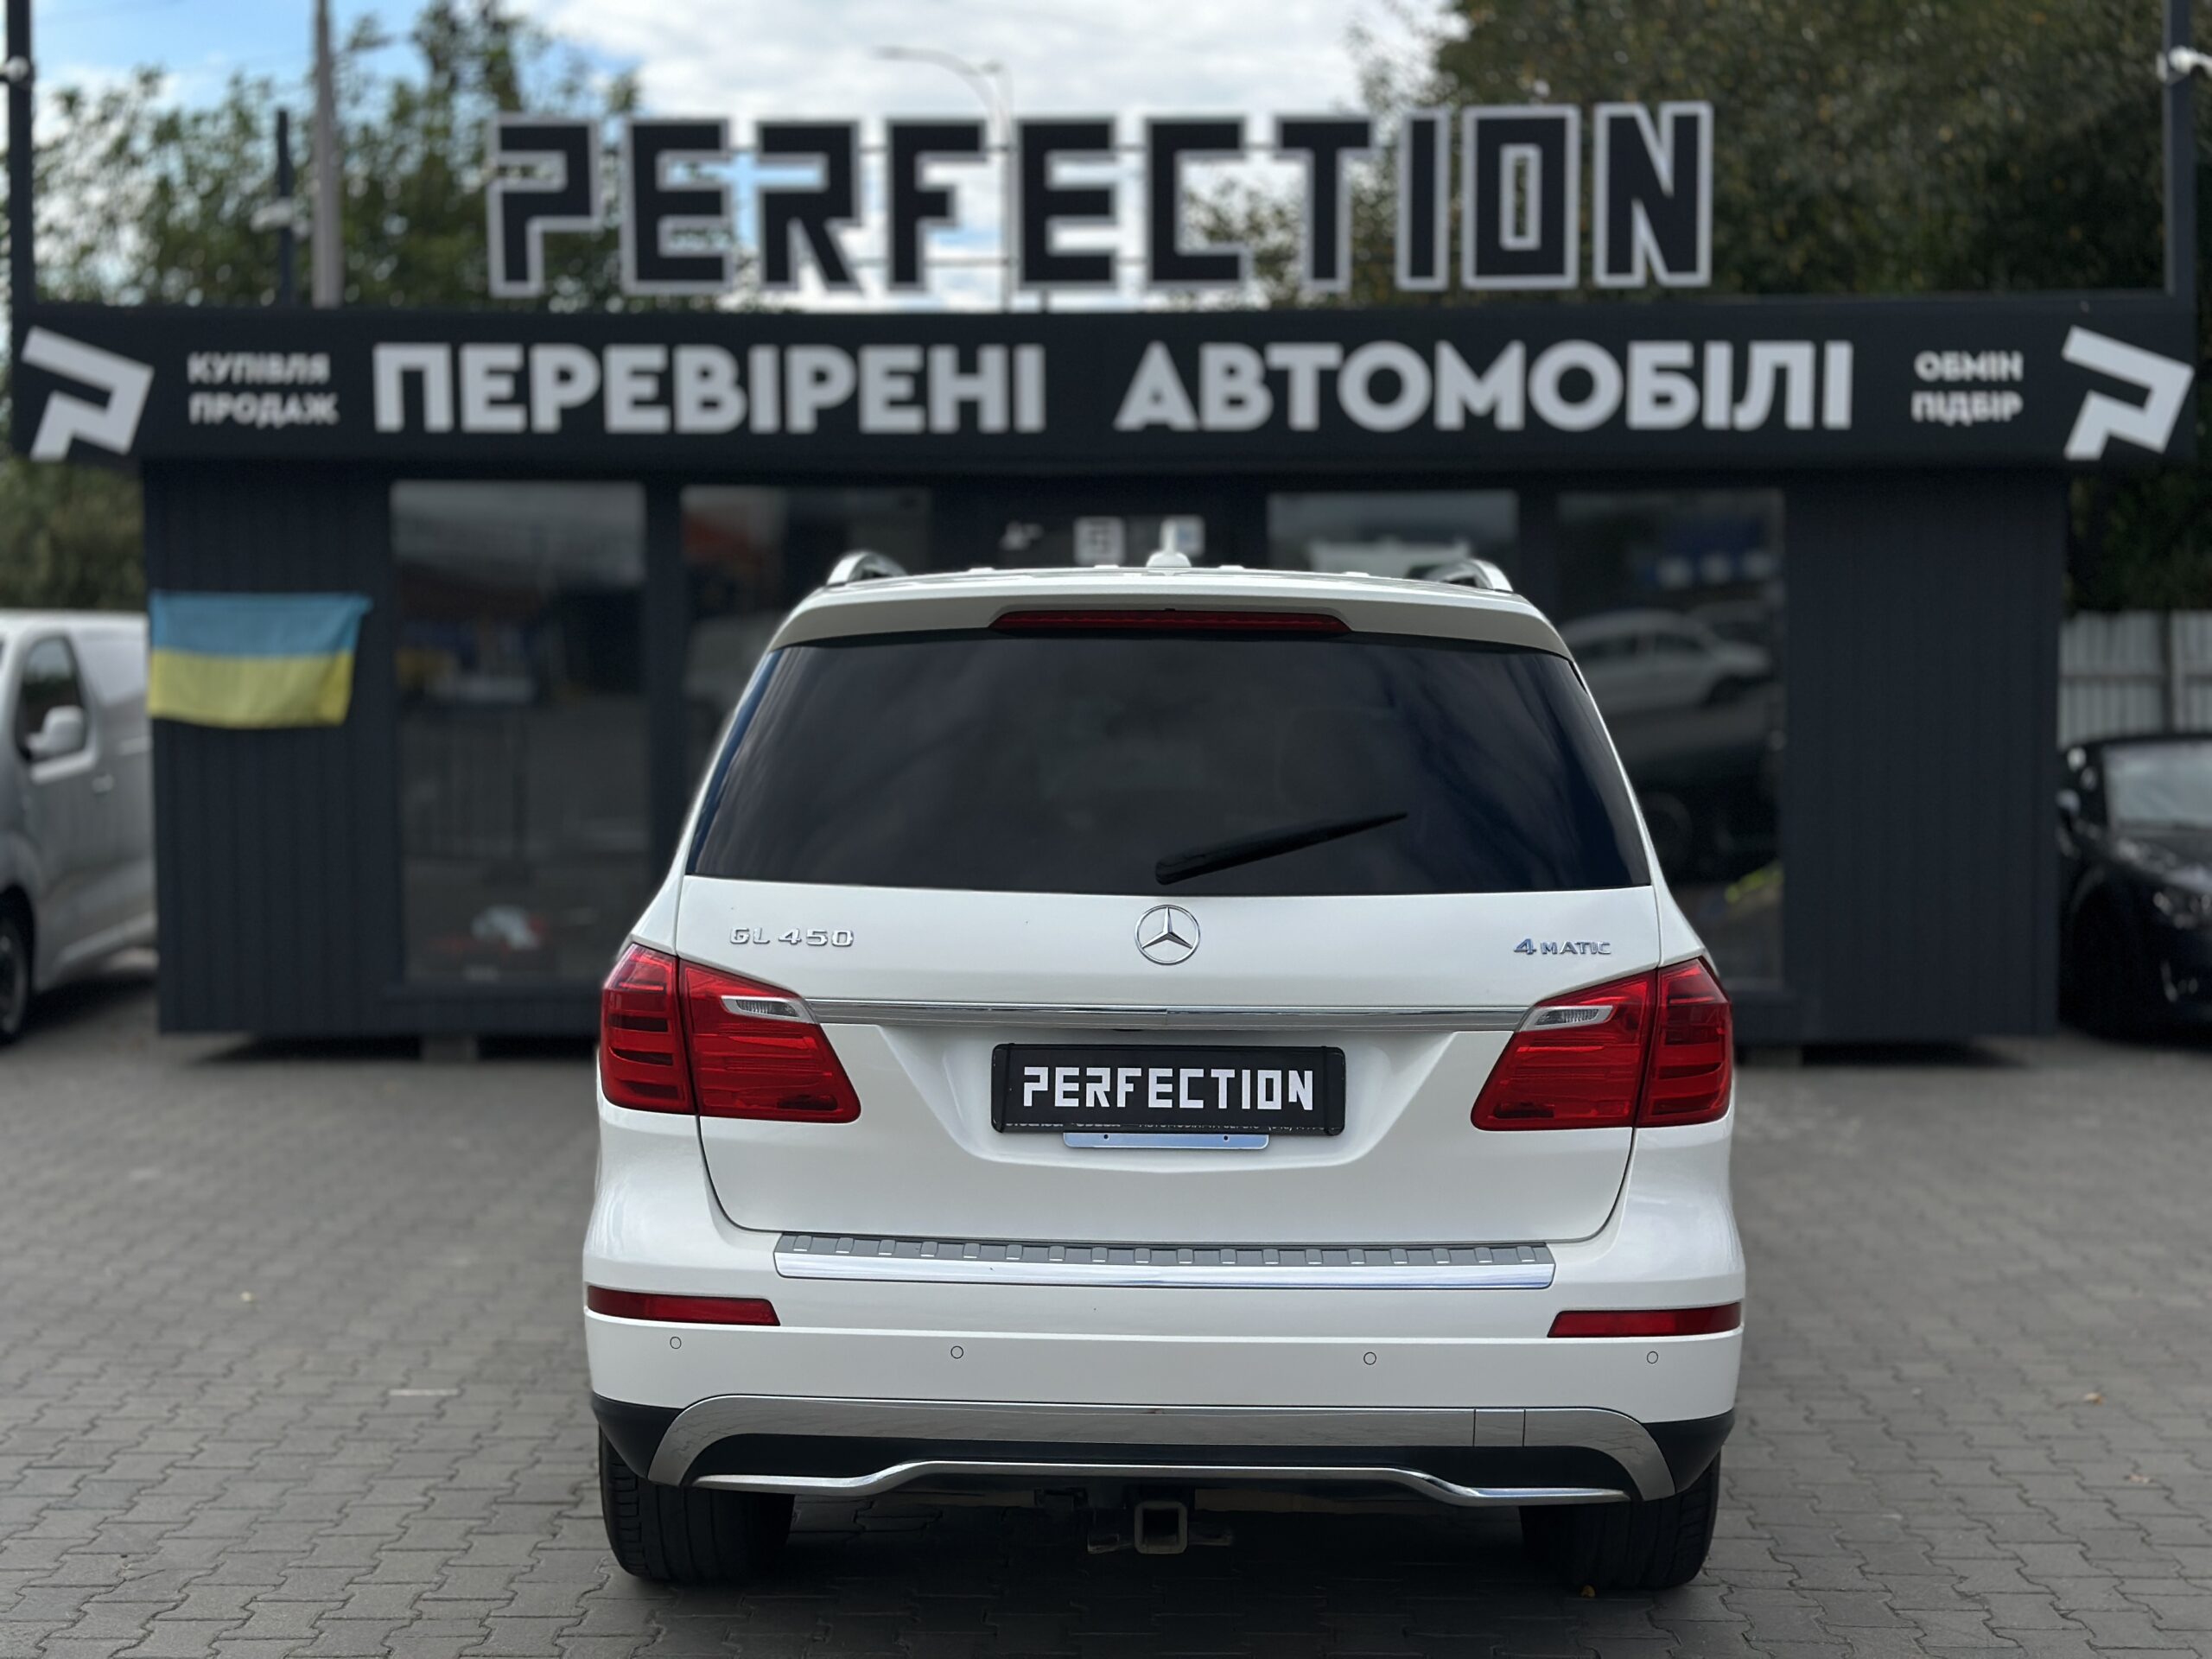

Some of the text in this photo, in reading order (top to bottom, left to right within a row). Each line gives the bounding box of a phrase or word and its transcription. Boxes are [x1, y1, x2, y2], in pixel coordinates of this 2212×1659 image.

[489, 102, 1714, 298] PERFECTION
[188, 352, 331, 385] КУПІВЛЯ
[1913, 350, 2024, 382] ОБМІН
[372, 340, 1853, 435] ПЕРЕВІРЕНІ АВТОМОБІЛІ
[188, 391, 340, 429] ПРОДАЖ
[1910, 391, 2024, 427] ПІДБІР
[729, 926, 855, 948] GL 450
[1023, 1066, 1313, 1111] PERFECTION
